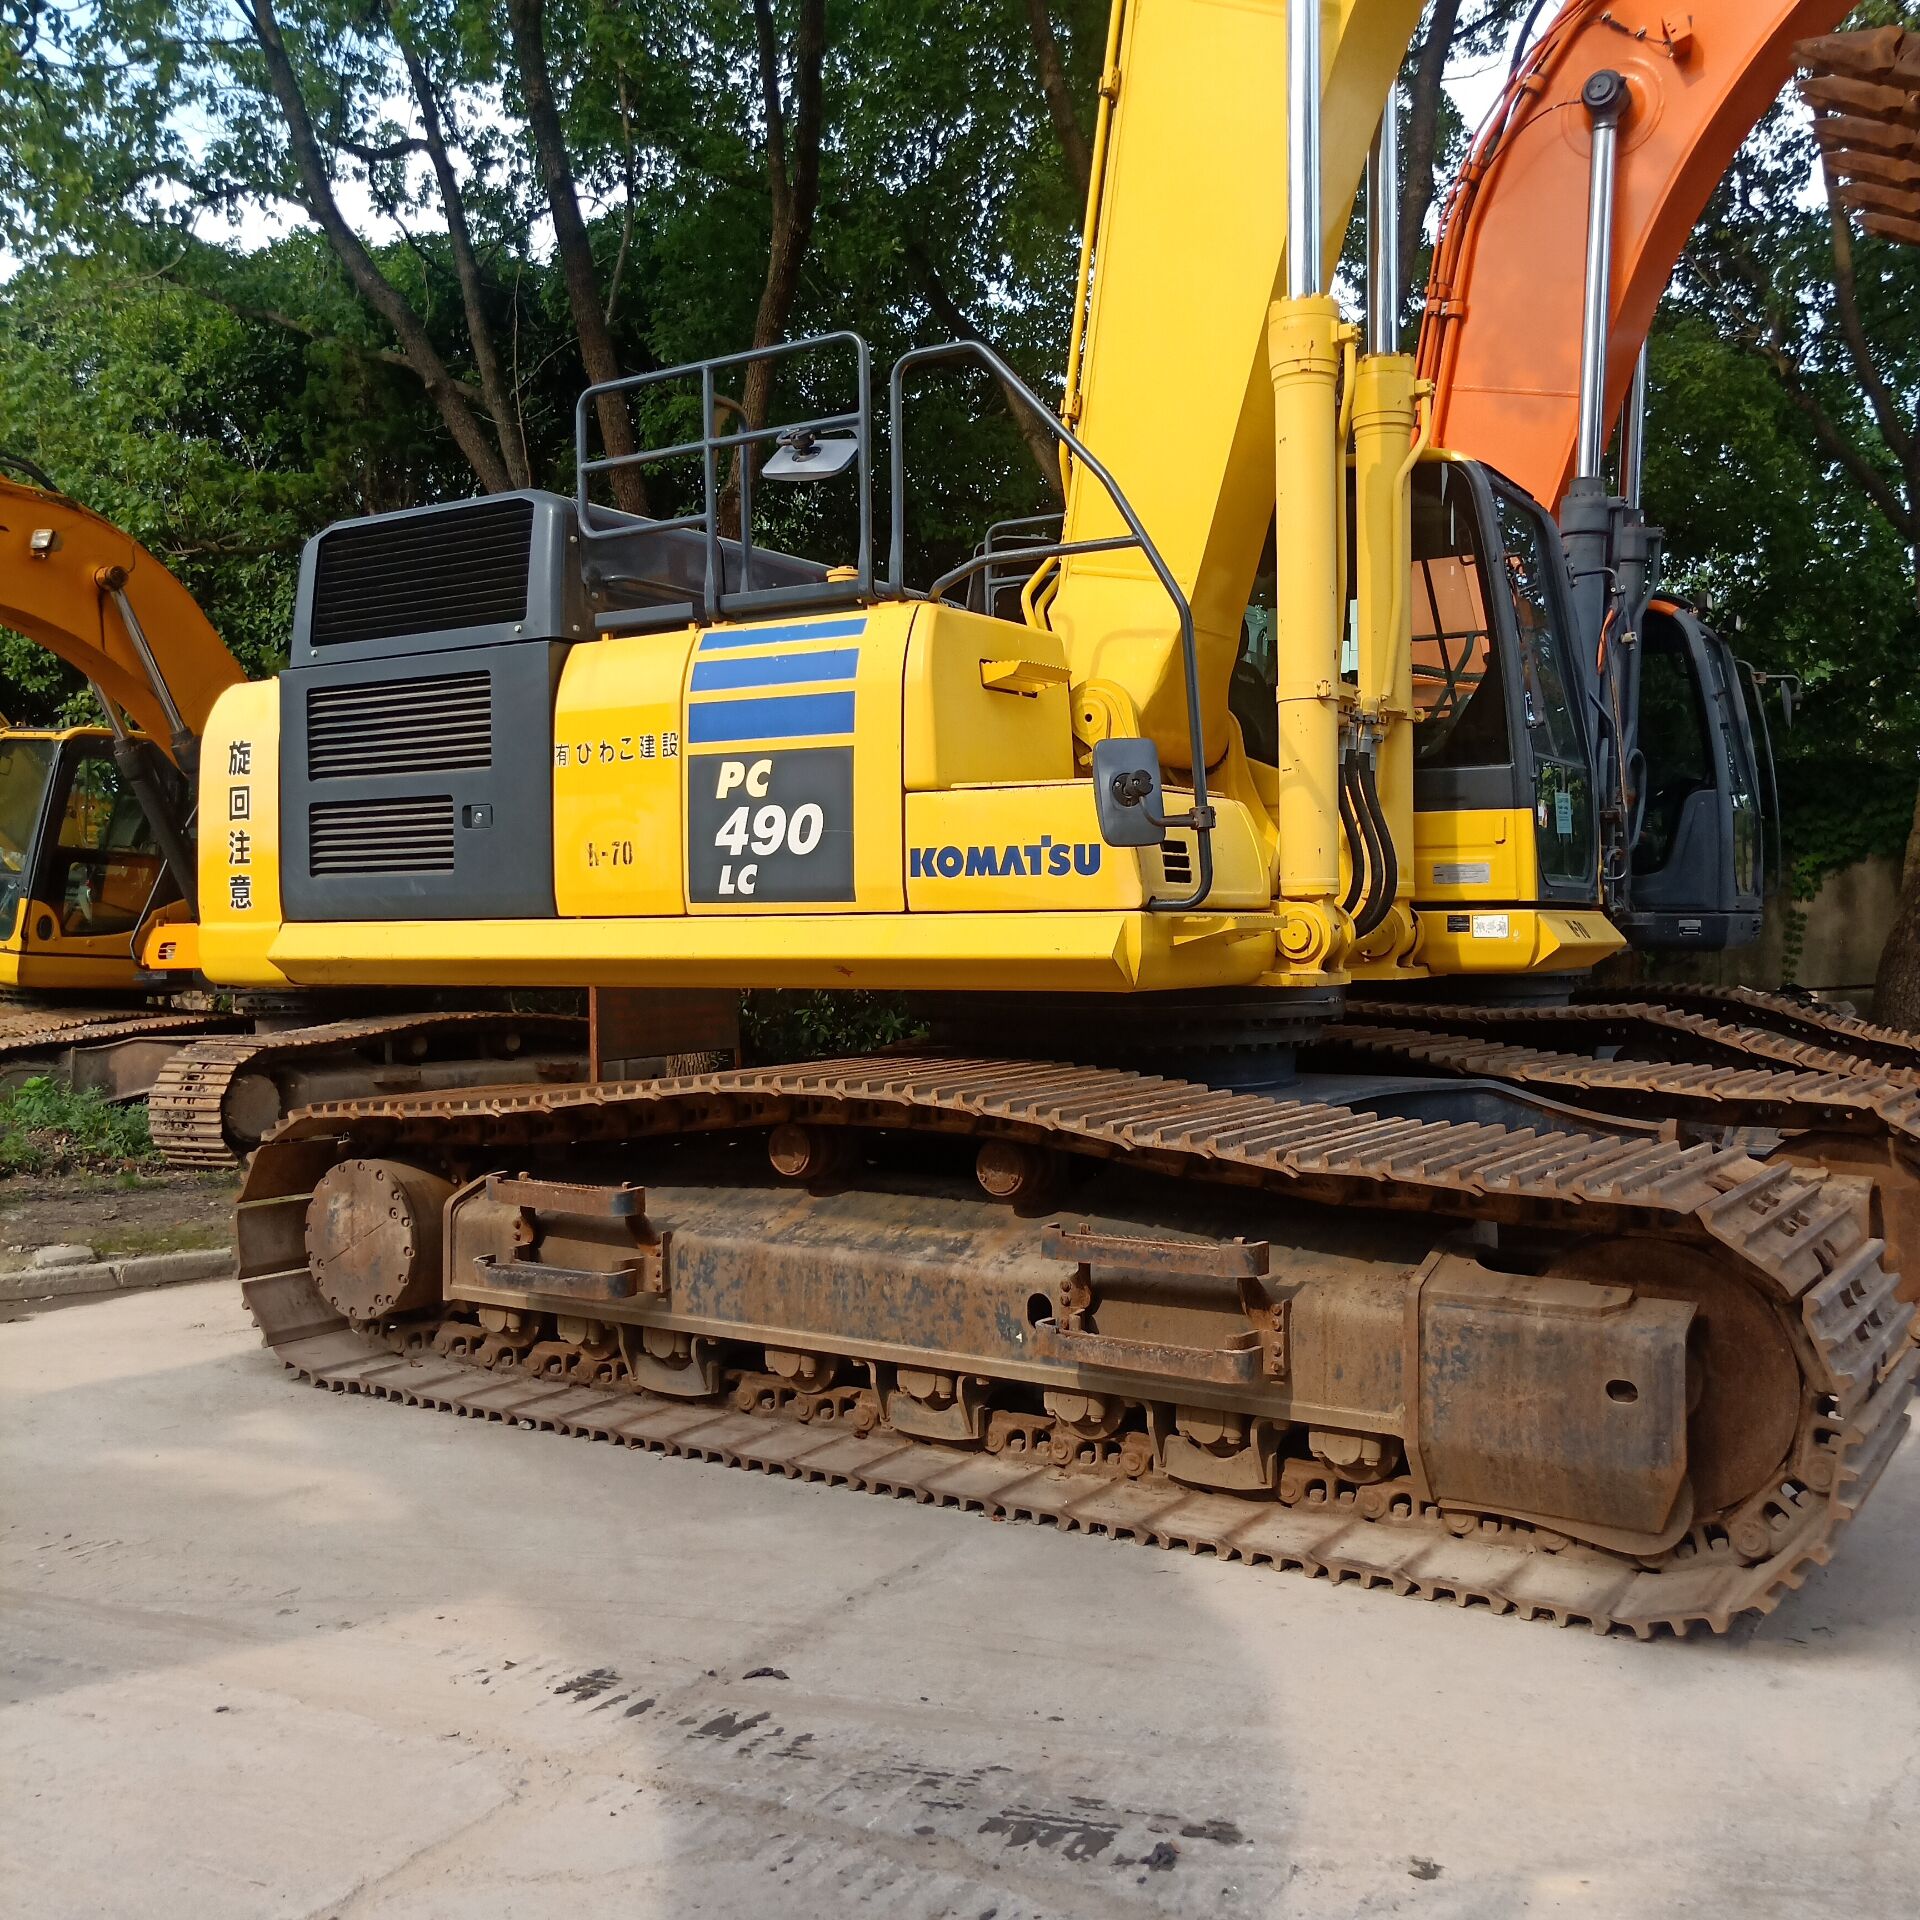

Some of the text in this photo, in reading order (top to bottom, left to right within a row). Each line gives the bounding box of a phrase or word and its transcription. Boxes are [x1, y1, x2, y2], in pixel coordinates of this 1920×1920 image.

[715, 759, 773, 799] PC
[228, 740, 252, 909] 旋回注意
[714, 803, 824, 856] 490
[910, 835, 1101, 878] KOMATSU
[718, 864, 758, 895] LC
